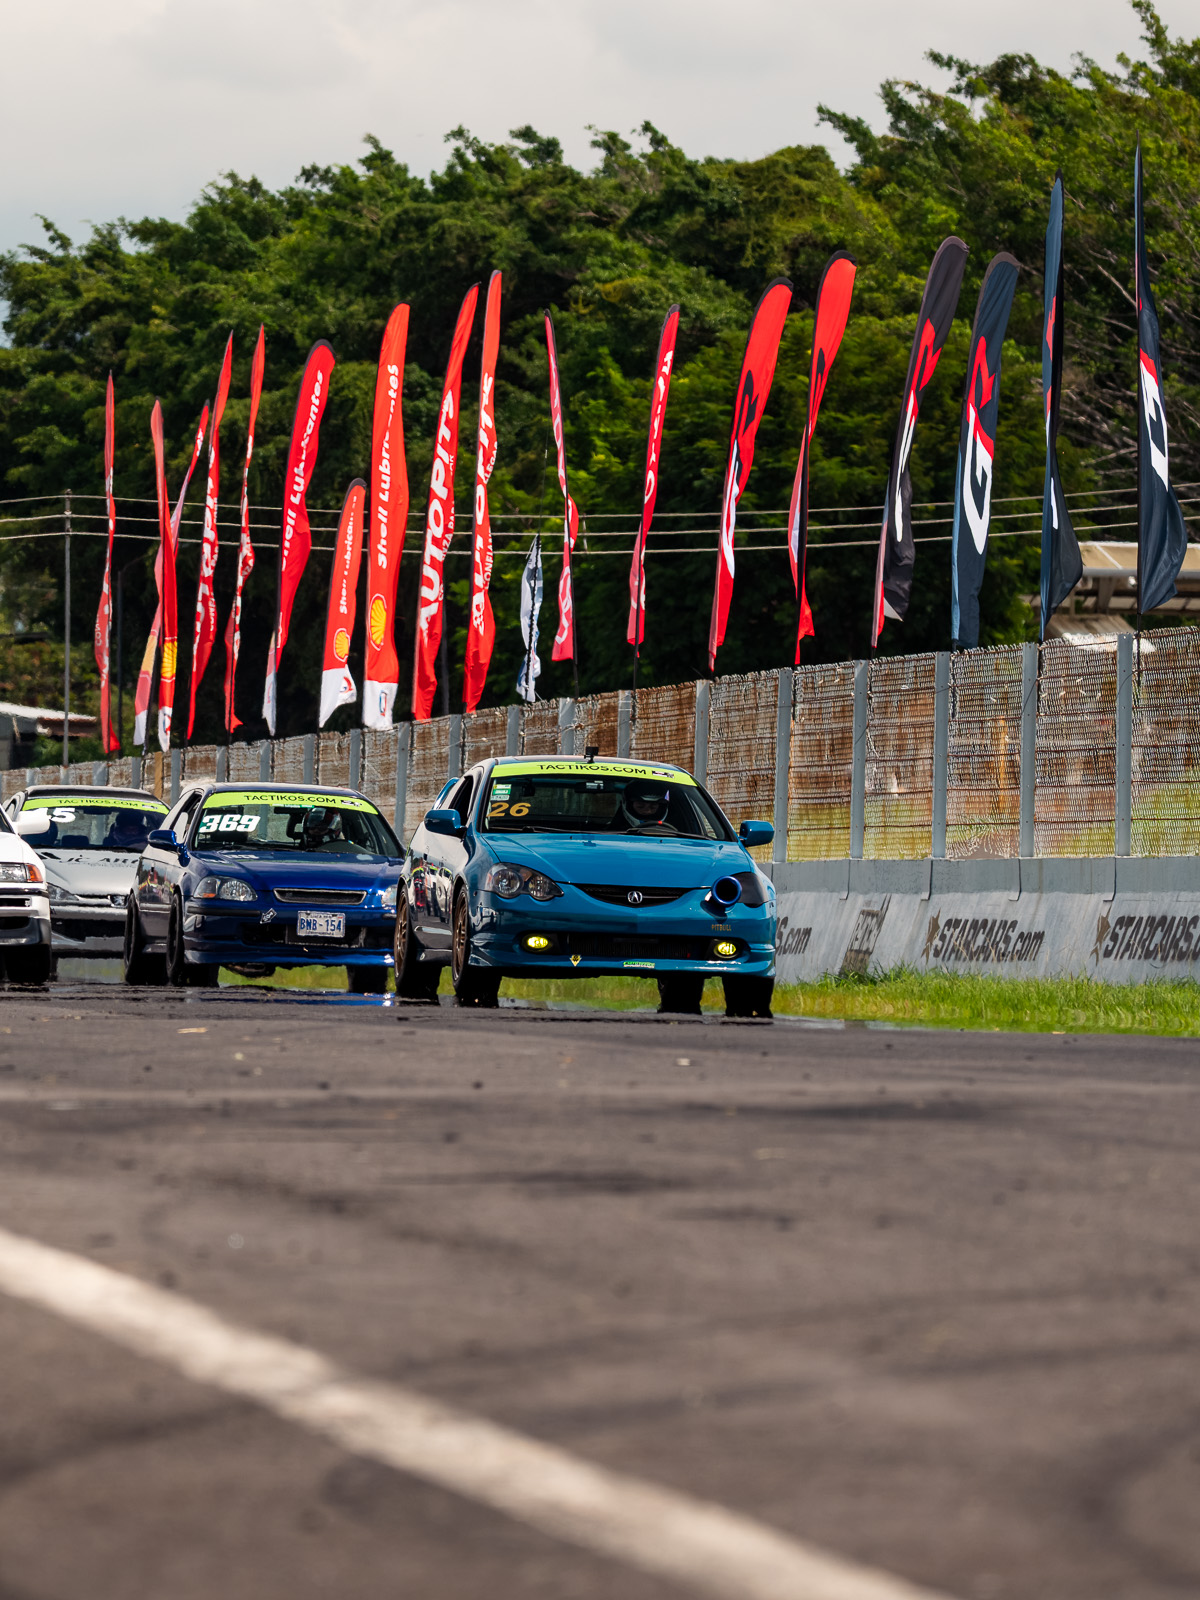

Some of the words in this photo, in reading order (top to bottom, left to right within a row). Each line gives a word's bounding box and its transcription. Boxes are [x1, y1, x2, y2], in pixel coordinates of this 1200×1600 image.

[378, 364, 400, 504] Lubrites
[962, 335, 996, 556] GR
[377, 509, 389, 569] Shell
[537, 764, 647, 775] TACTIKOS.COM
[244, 795, 336, 804] TACTIKOS.COM
[486, 802, 531, 817] 26
[199, 814, 261, 833] 369
[932, 917, 1046, 963] STARCARS.com
